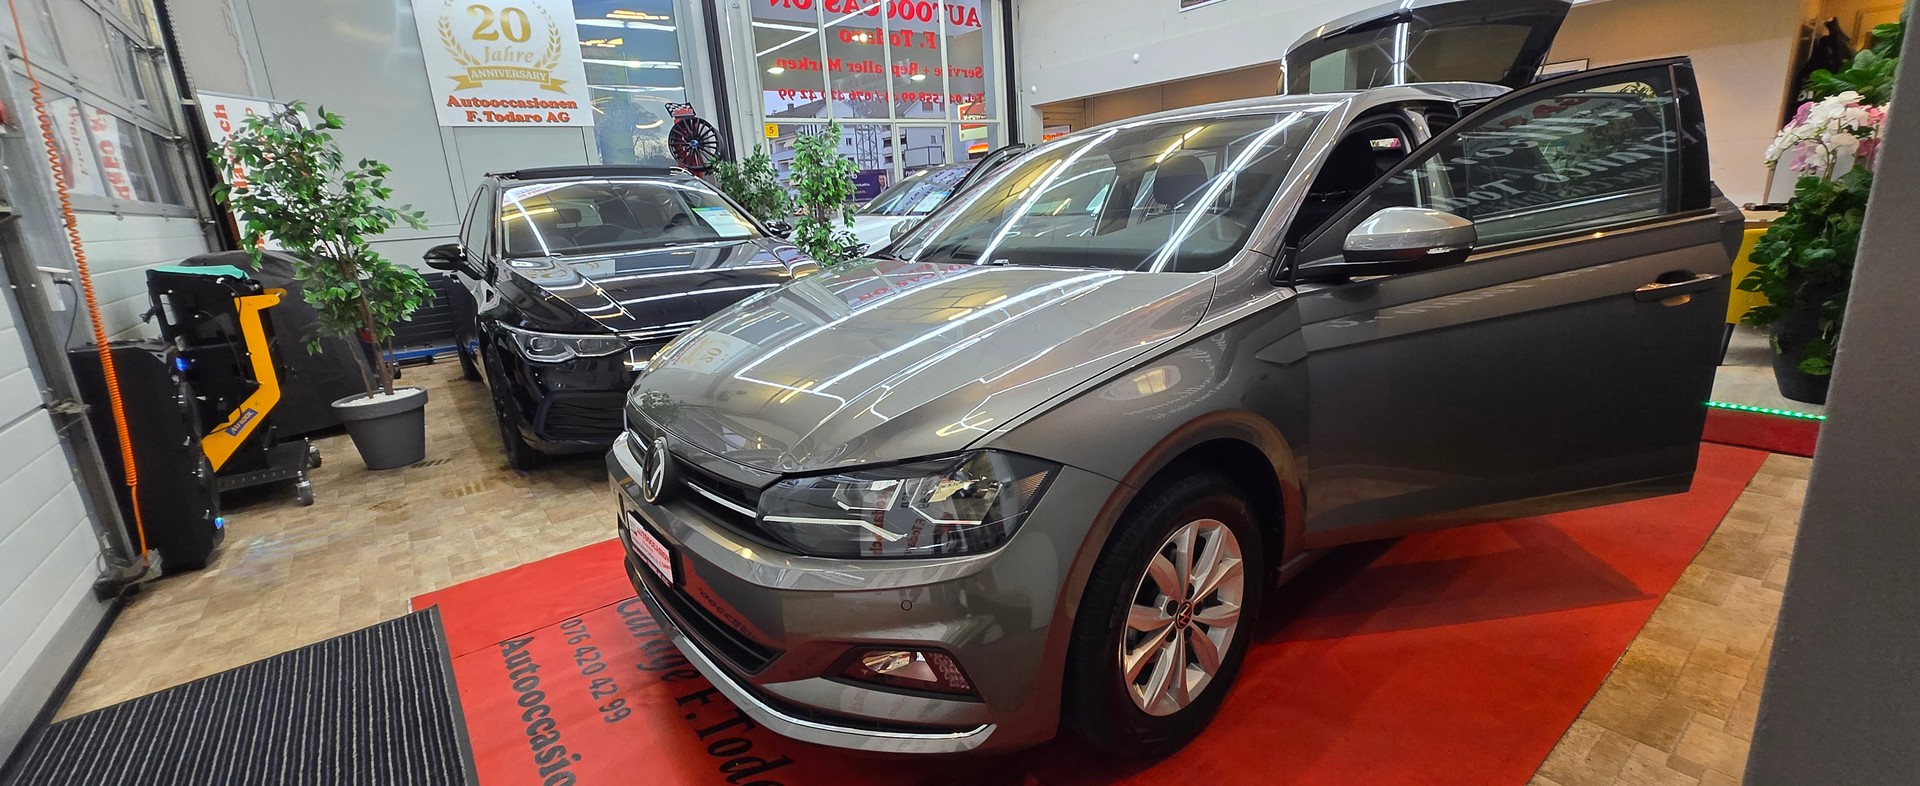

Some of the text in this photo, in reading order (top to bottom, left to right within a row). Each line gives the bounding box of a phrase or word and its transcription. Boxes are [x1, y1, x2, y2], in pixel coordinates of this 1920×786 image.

[467, 4, 532, 43] 20
[484, 45, 534, 64] Jahre
[471, 69, 547, 81] ANNIVERSARY
[447, 94, 578, 110] Autooccasionen
[546, 111, 571, 123] AG
[231, 411, 254, 435] AUTOOL
[559, 618, 632, 724] 076 420 42 99
